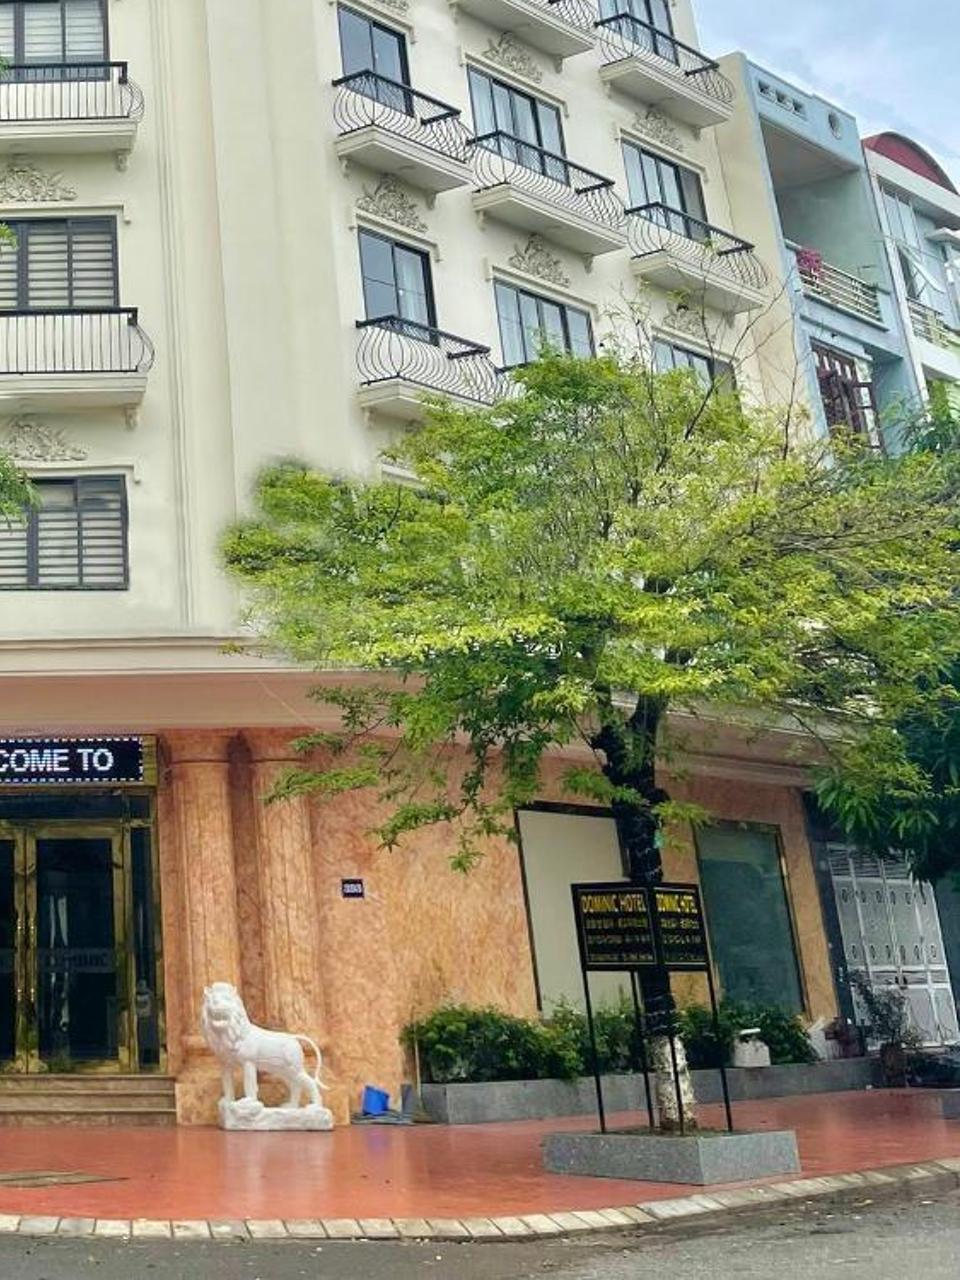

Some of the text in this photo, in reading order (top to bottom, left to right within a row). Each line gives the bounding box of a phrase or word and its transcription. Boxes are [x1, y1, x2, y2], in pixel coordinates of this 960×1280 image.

[76, 748, 114, 771] TO
[580, 893, 647, 913] DOMINIC HOTEL
